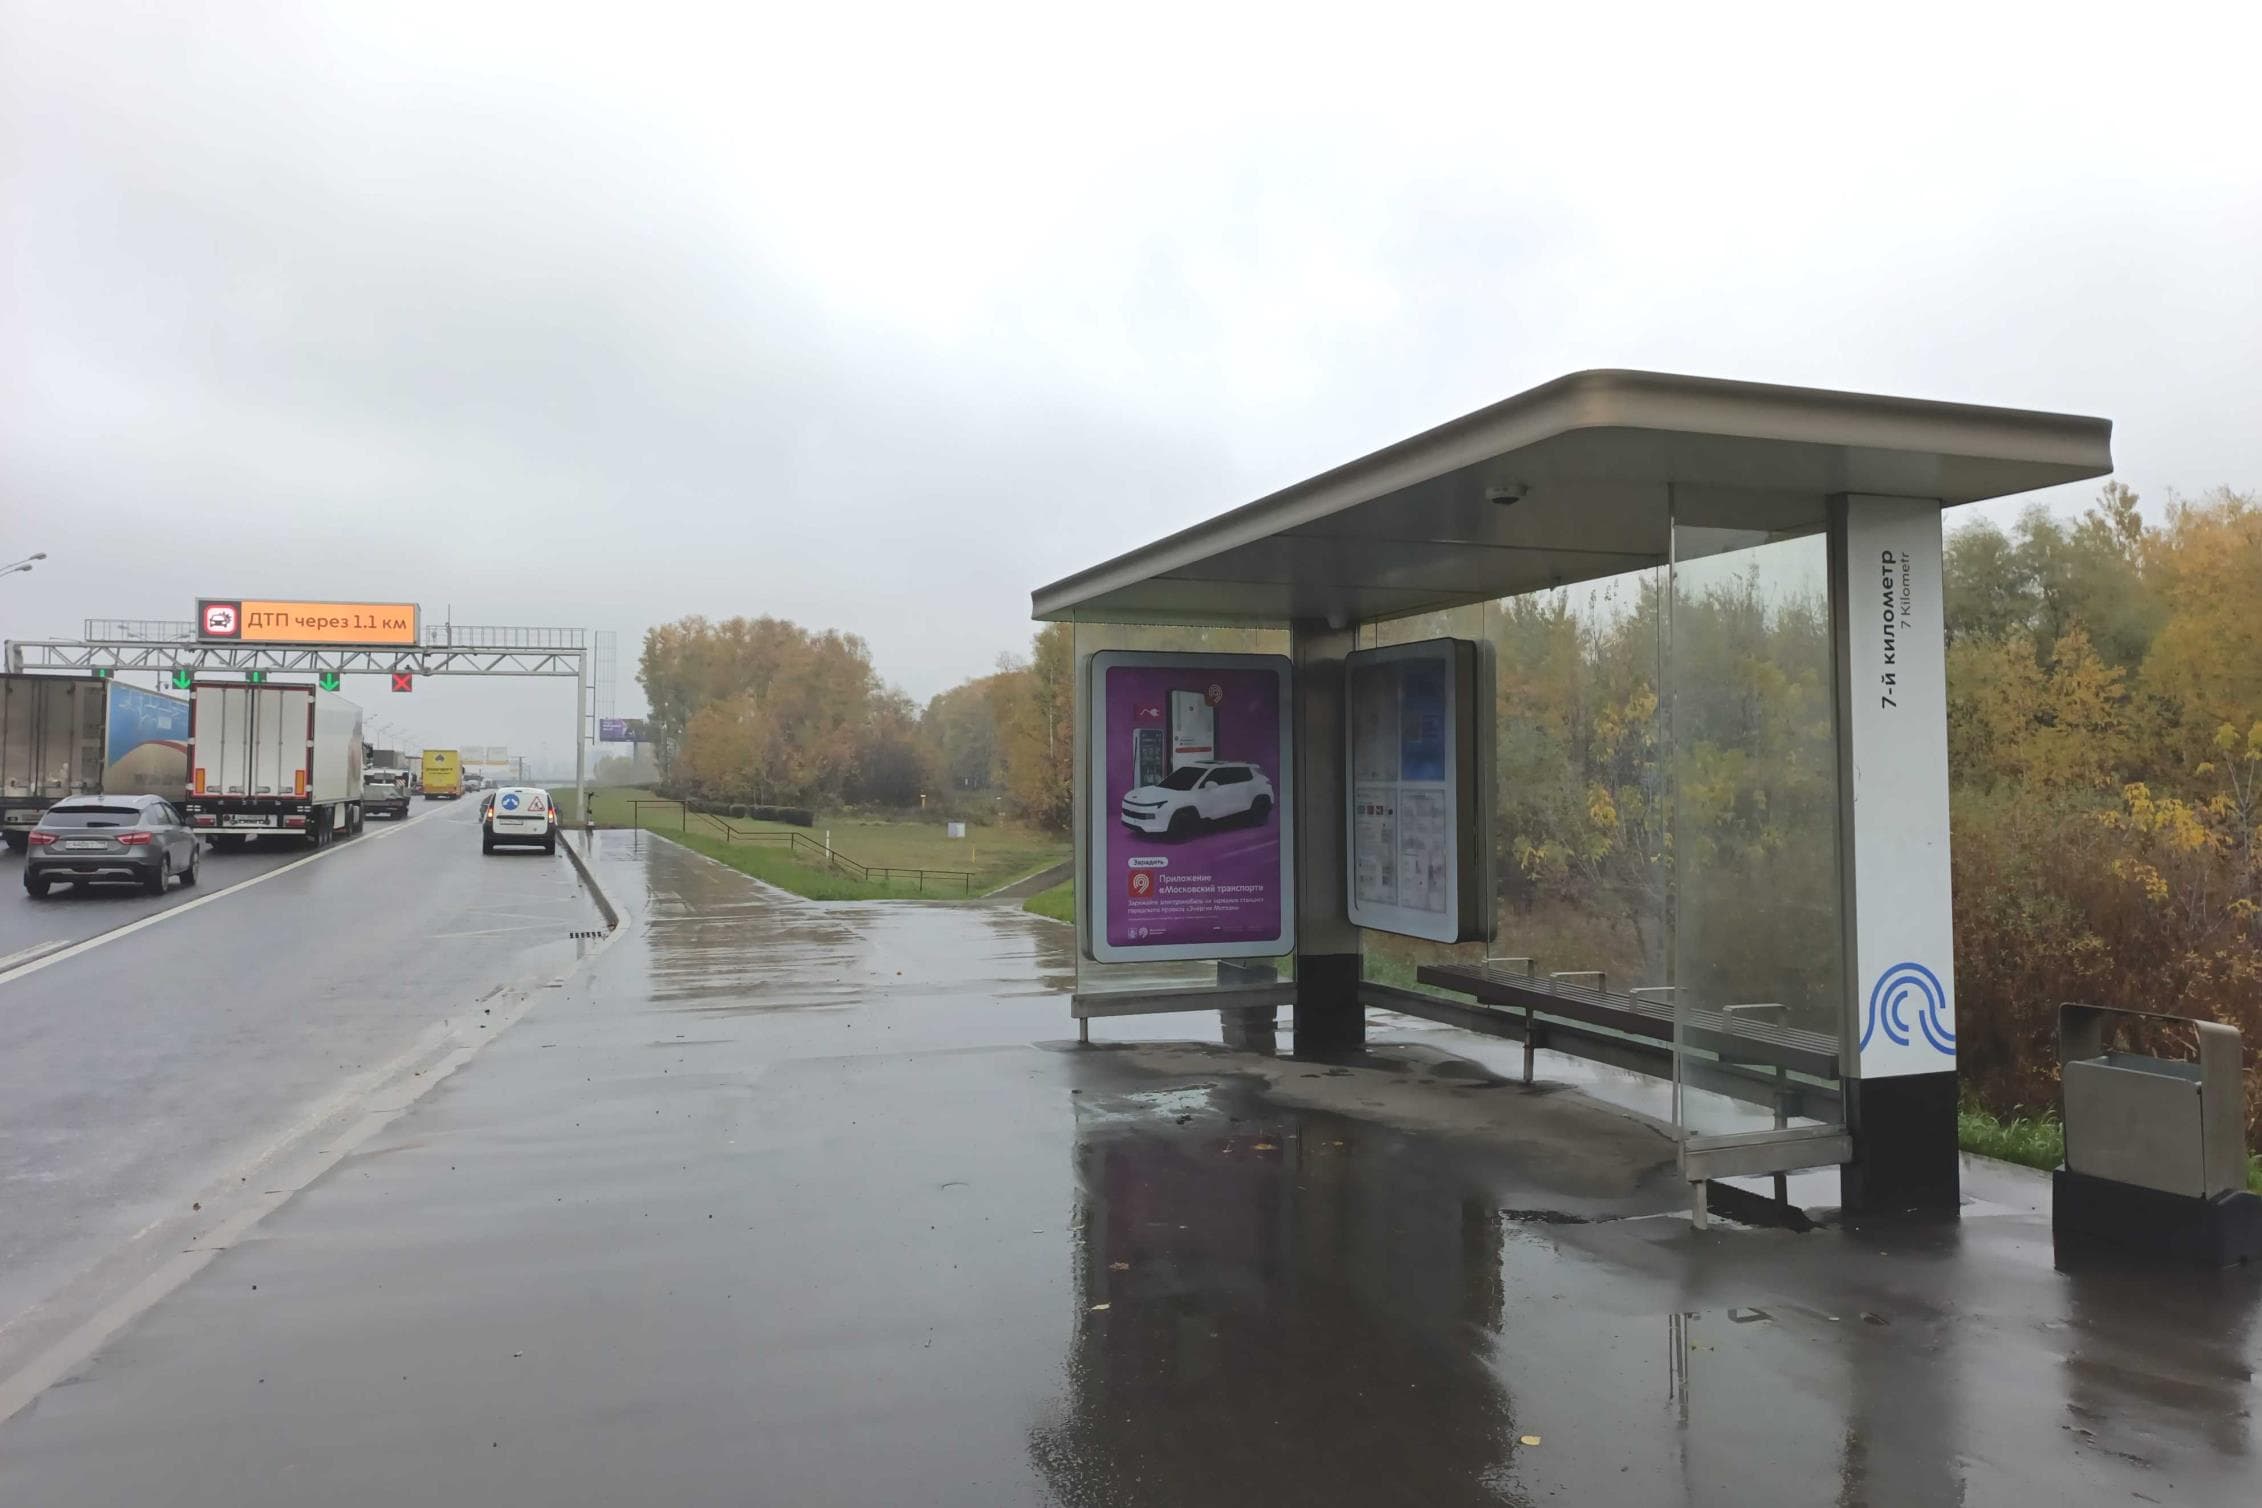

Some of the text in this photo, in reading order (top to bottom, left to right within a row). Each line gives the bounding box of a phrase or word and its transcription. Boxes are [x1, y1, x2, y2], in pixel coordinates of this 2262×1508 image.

[1900, 552, 1911, 629] 7 Kilometr
[247, 612, 407, 630] ДТП через 1.1 км
[1881, 550, 1897, 709] 7-й километр
[1159, 874, 1212, 884] Приложение
[1159, 884, 1215, 894] «Московский
